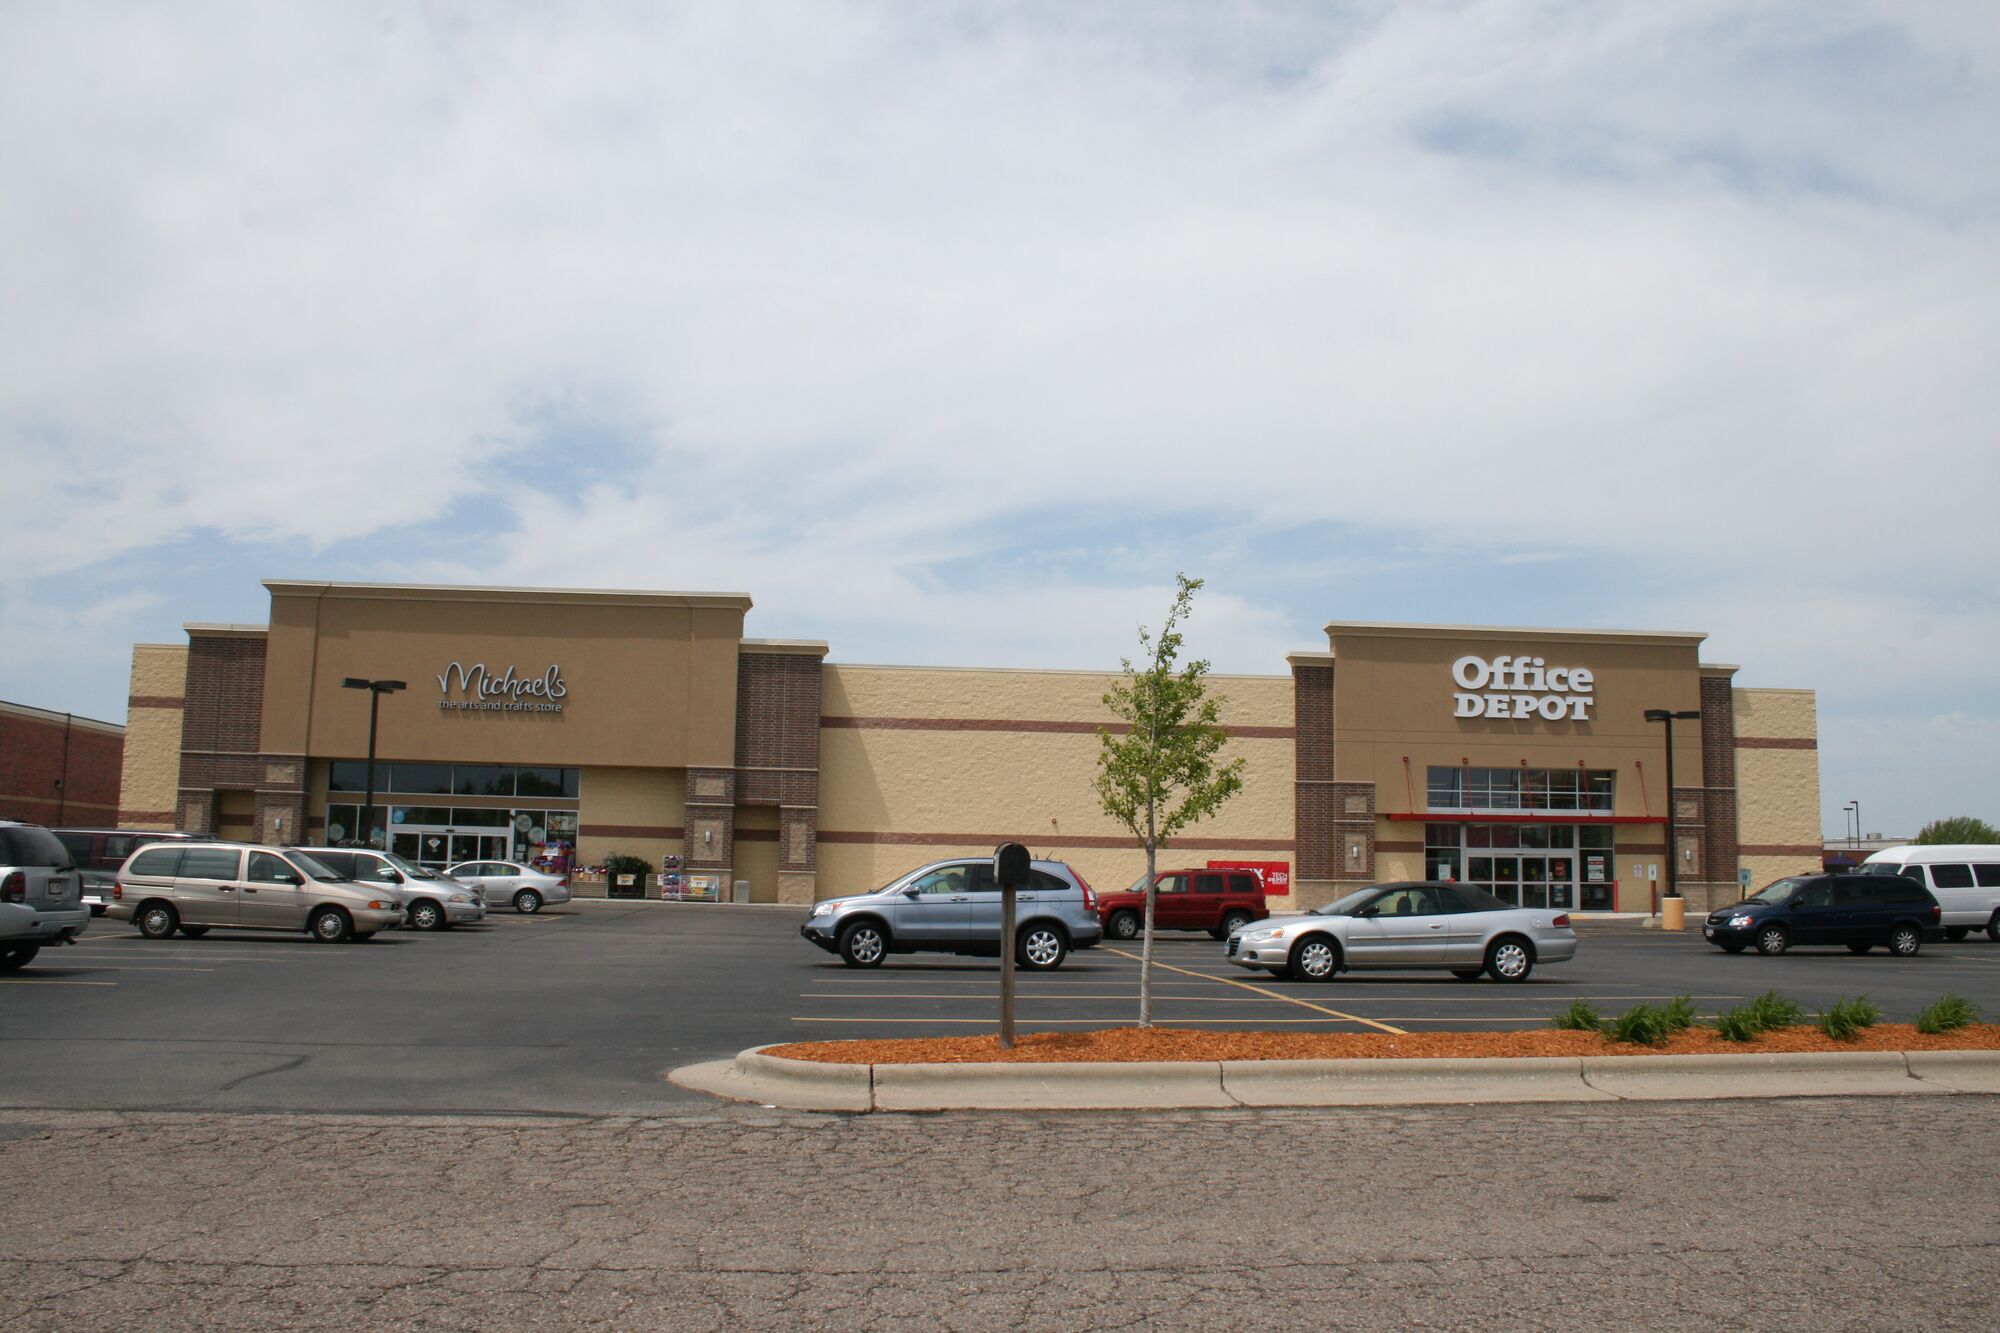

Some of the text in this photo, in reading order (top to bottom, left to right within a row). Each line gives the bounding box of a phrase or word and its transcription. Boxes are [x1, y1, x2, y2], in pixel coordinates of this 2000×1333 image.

[437, 662, 567, 702] Michaels
[1452, 655, 1594, 692] Office
[439, 700, 562, 712] the arts and crafts store
[1453, 693, 1594, 721] DEPOT
